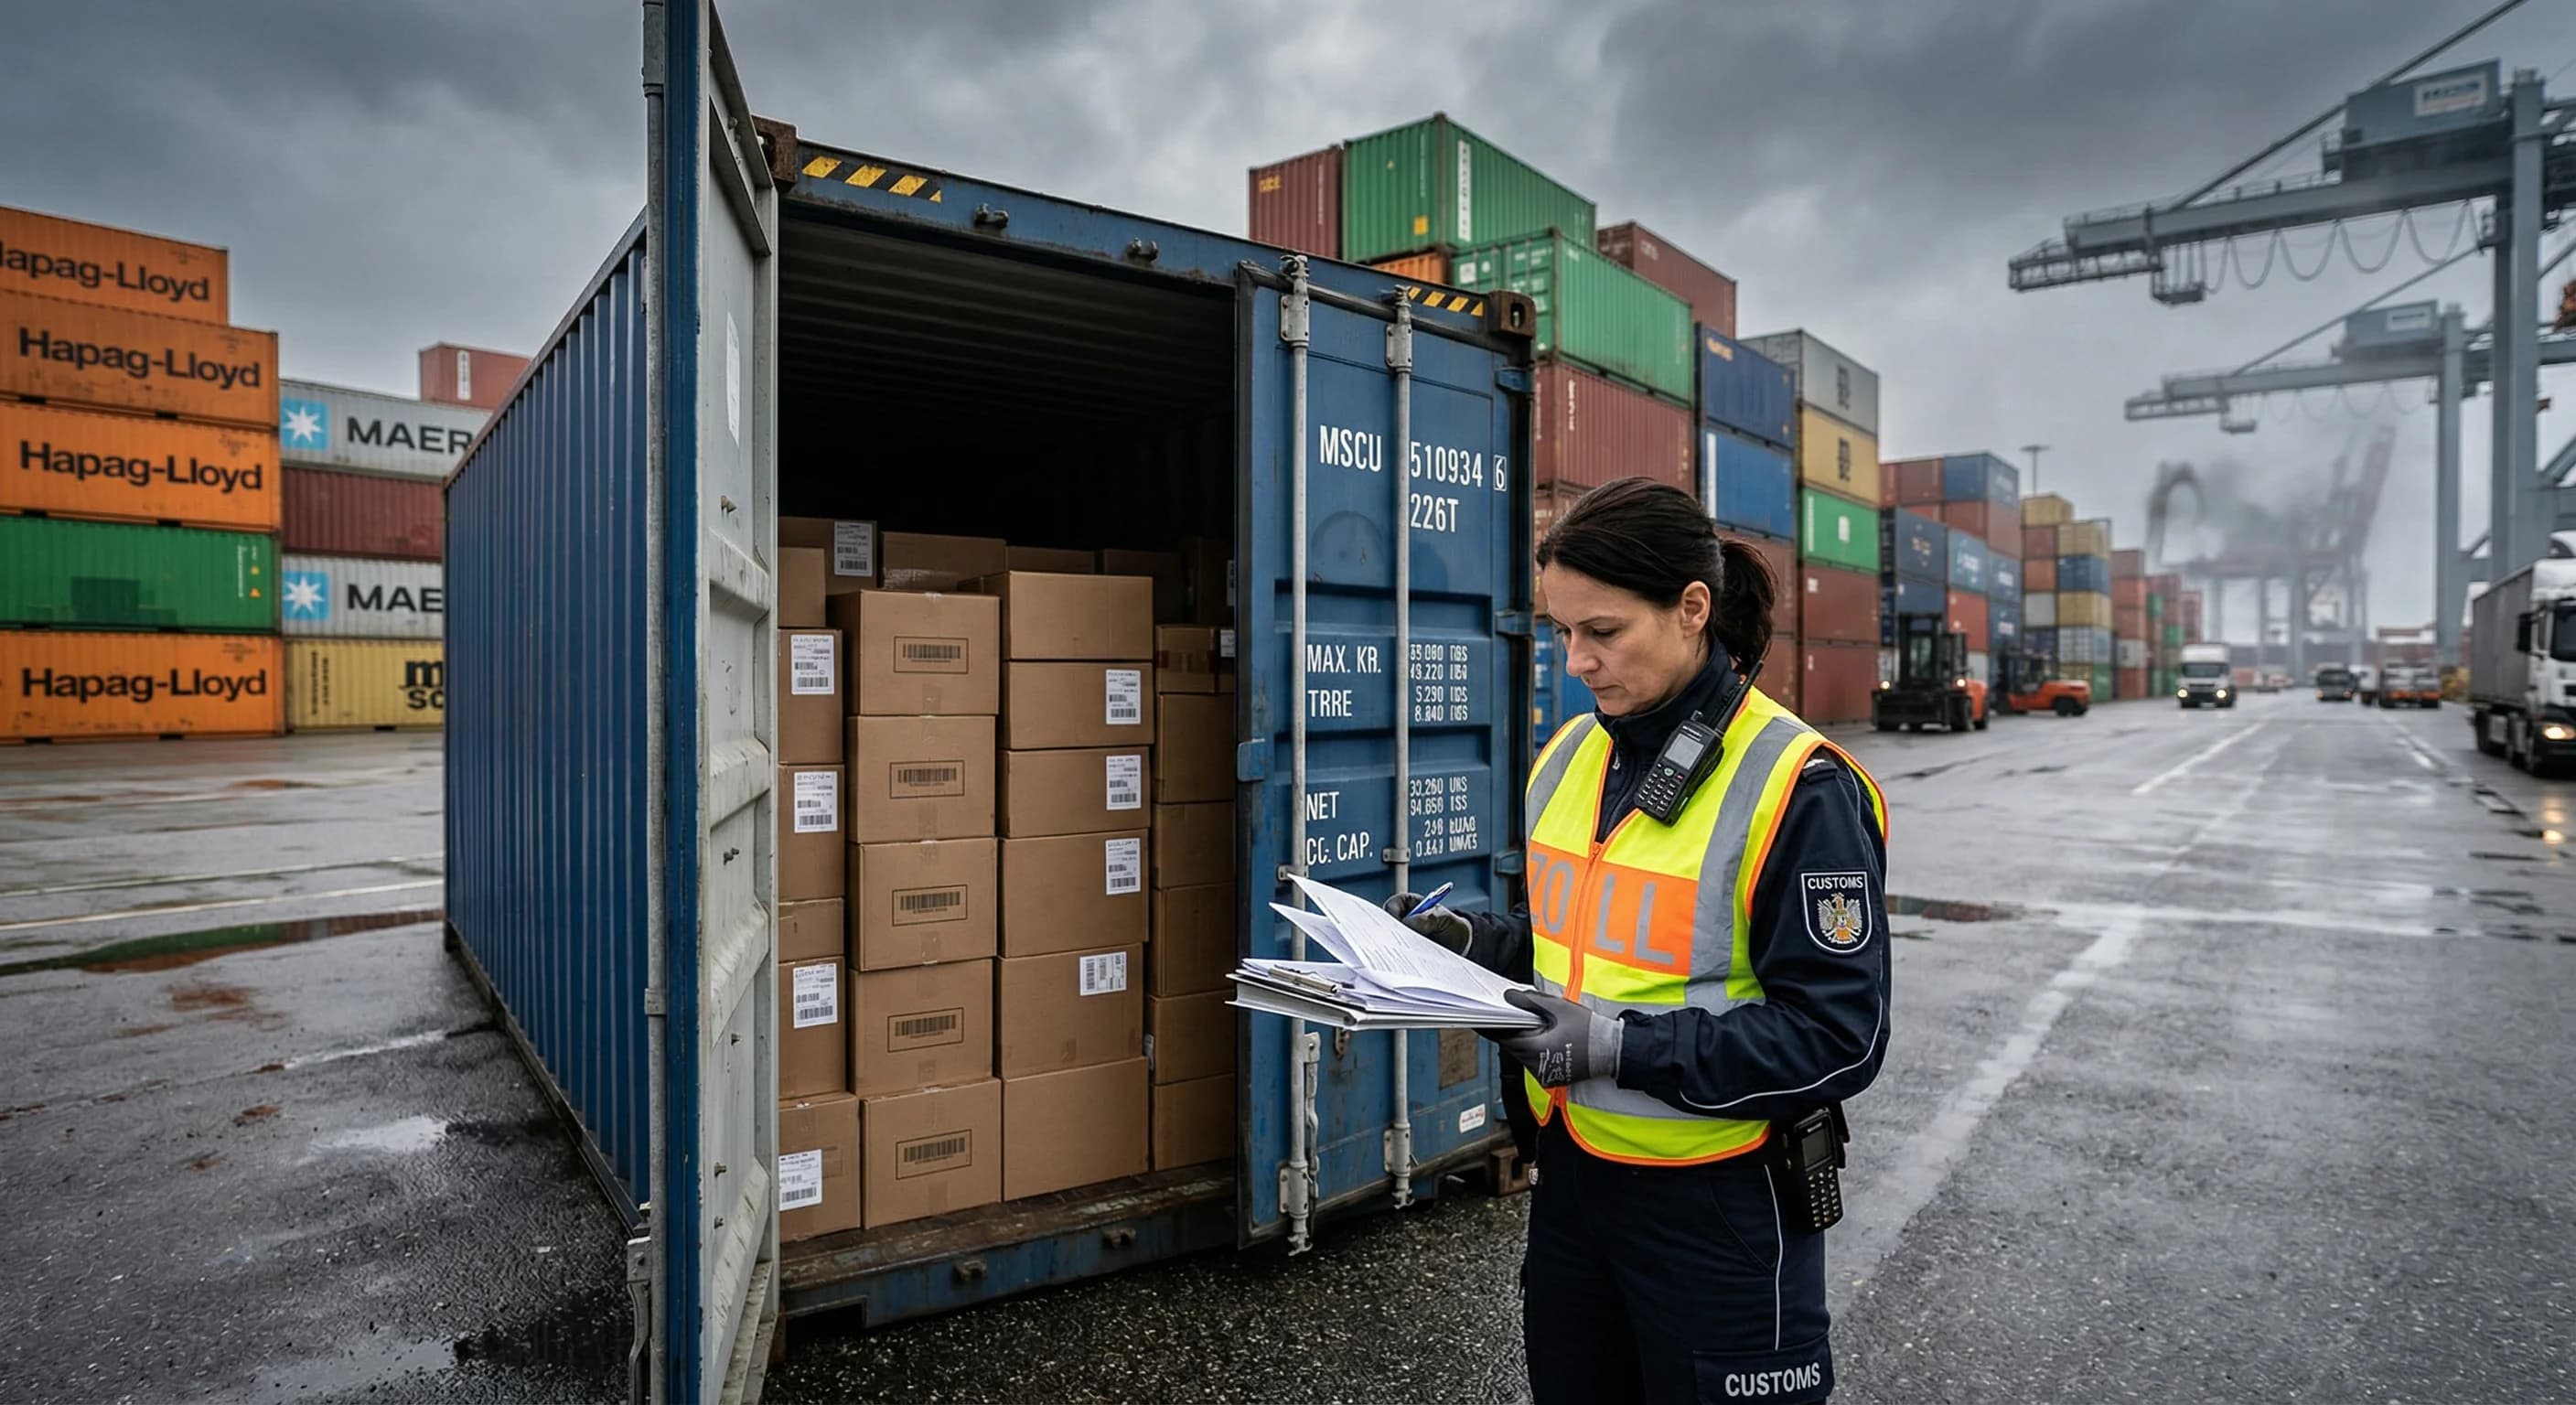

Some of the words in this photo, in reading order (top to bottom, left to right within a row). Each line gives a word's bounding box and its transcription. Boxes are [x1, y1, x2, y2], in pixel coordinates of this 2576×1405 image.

[0, 241, 209, 303] apag-Lloyd
[18, 327, 260, 390] Hapag-Lloyd
[20, 440, 263, 495] Hapag-Lloyd
[1319, 424, 1382, 473] MSCU
[1410, 441, 1484, 488] 510934
[1495, 456, 1505, 489] 6
[1410, 493, 1459, 532] 226T
[347, 583, 444, 614] MAE
[1307, 644, 1351, 673] MAX.
[1357, 646, 1382, 673] KR.
[22, 668, 266, 703] Hapag-Lloyd
[1307, 690, 1353, 717] TRRE
[1306, 791, 1339, 821] NET
[1337, 831, 1373, 862] CAP.
[1808, 876, 1863, 890] CUSTOMS
[1530, 852, 1674, 966] ZOLL
[1725, 1362, 1820, 1398] CUSTOMS
